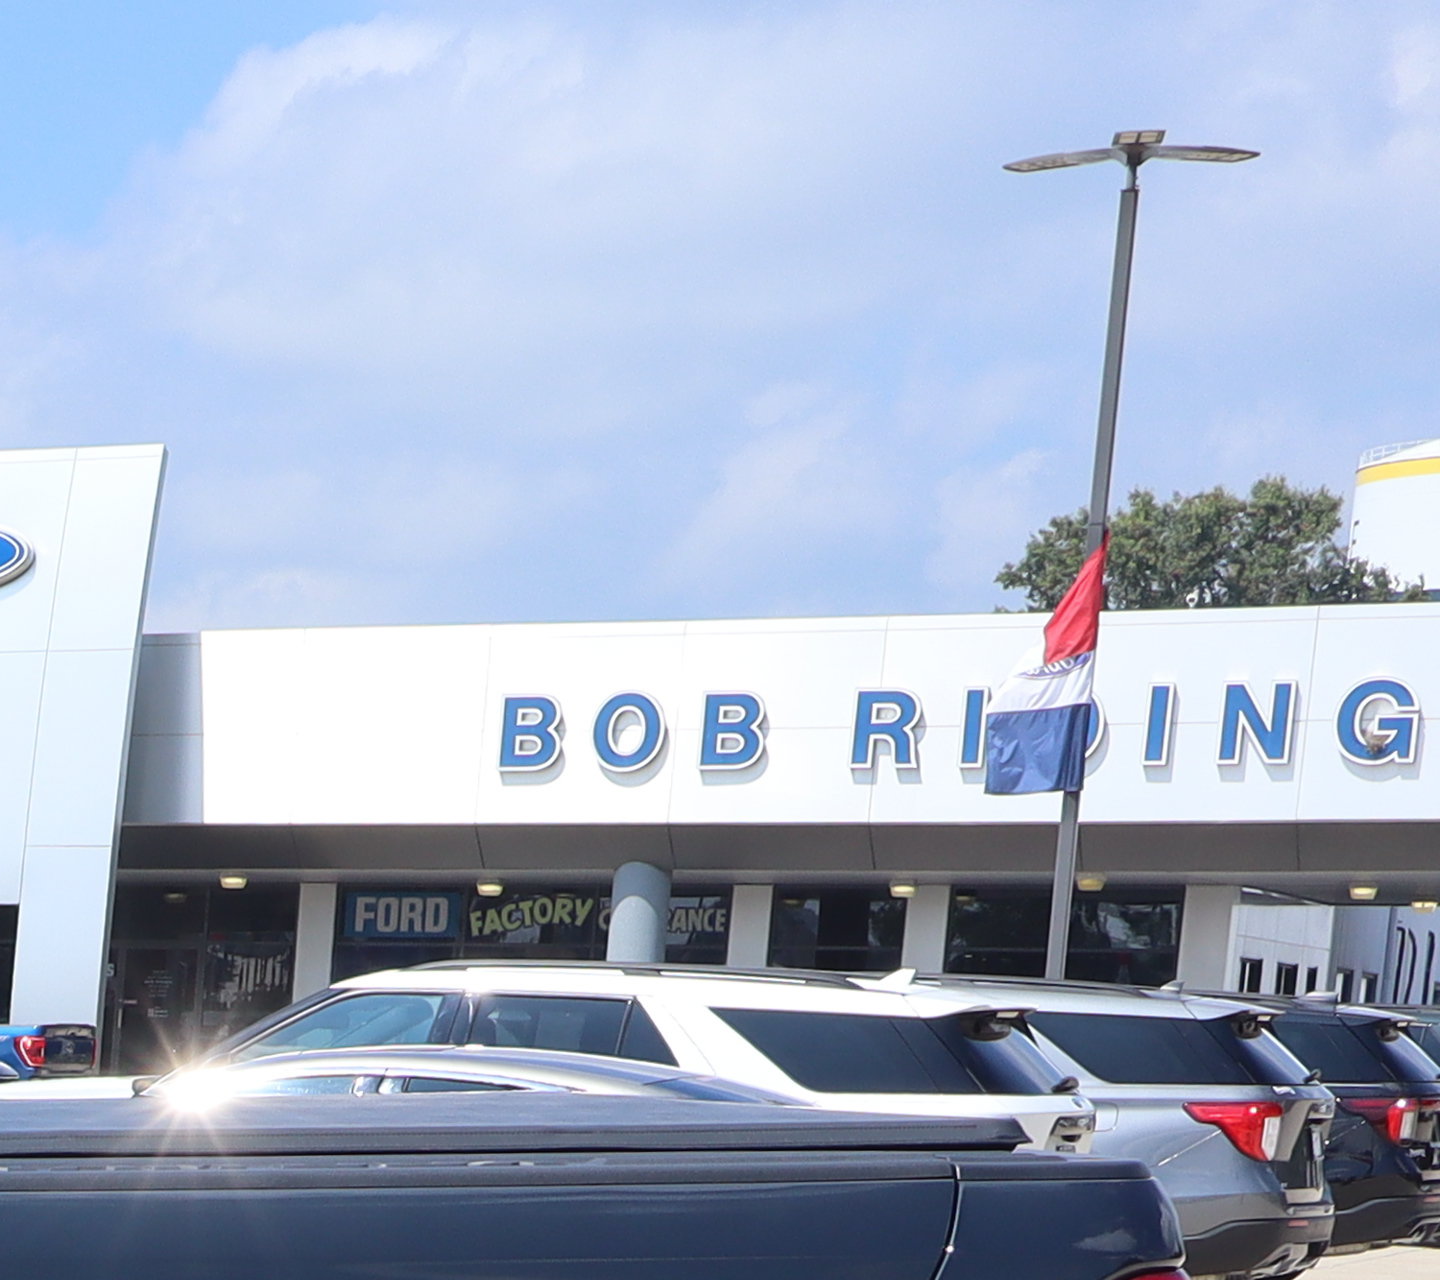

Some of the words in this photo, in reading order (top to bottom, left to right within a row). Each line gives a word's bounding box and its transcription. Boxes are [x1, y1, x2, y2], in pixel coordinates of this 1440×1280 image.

[496, 690, 768, 772] BOB
[354, 896, 449, 933] FORD
[469, 897, 594, 937] FACTORY
[597, 908, 727, 932] CANCE
